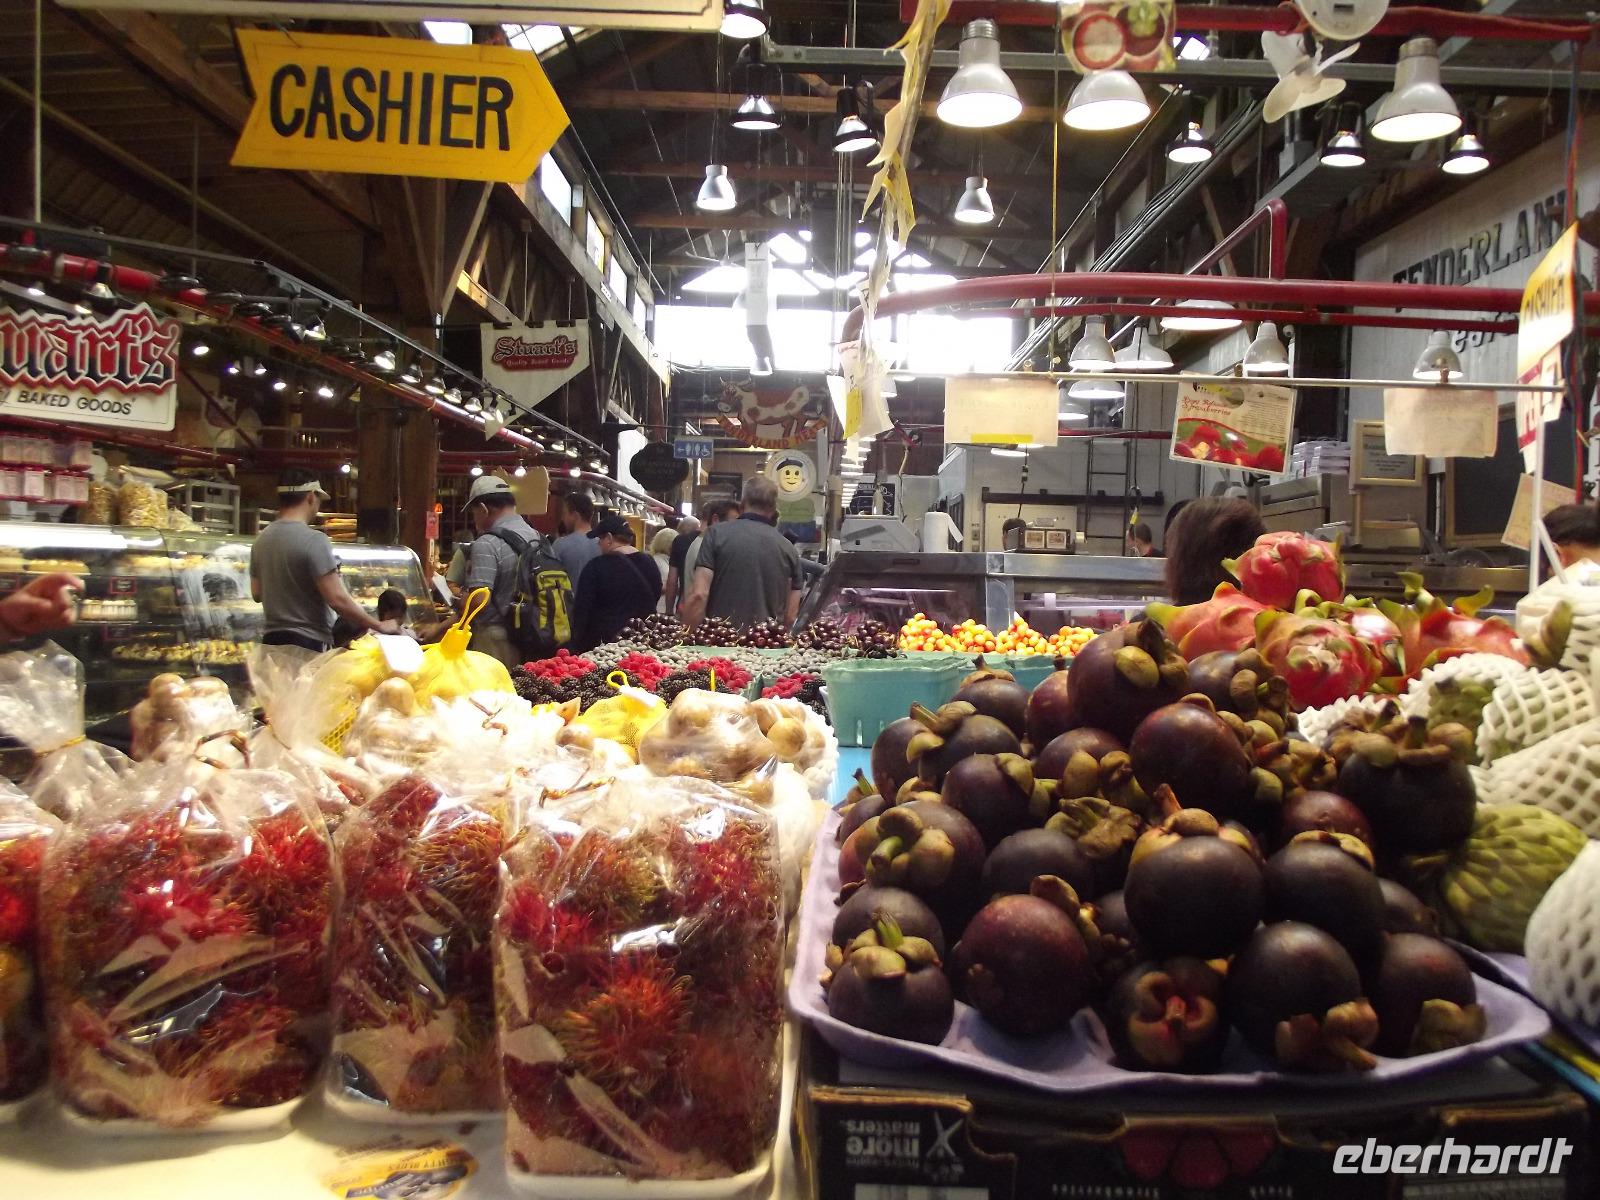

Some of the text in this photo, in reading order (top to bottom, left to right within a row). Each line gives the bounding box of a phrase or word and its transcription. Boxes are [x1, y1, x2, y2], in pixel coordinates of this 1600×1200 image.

[270, 64, 514, 151] CASHIER
[0, 316, 179, 388] uart's
[493, 336, 576, 361] Stuart's
[17, 390, 70, 408] BAKED
[77, 397, 132, 415] GOODS
[847, 1136, 920, 1157] more
